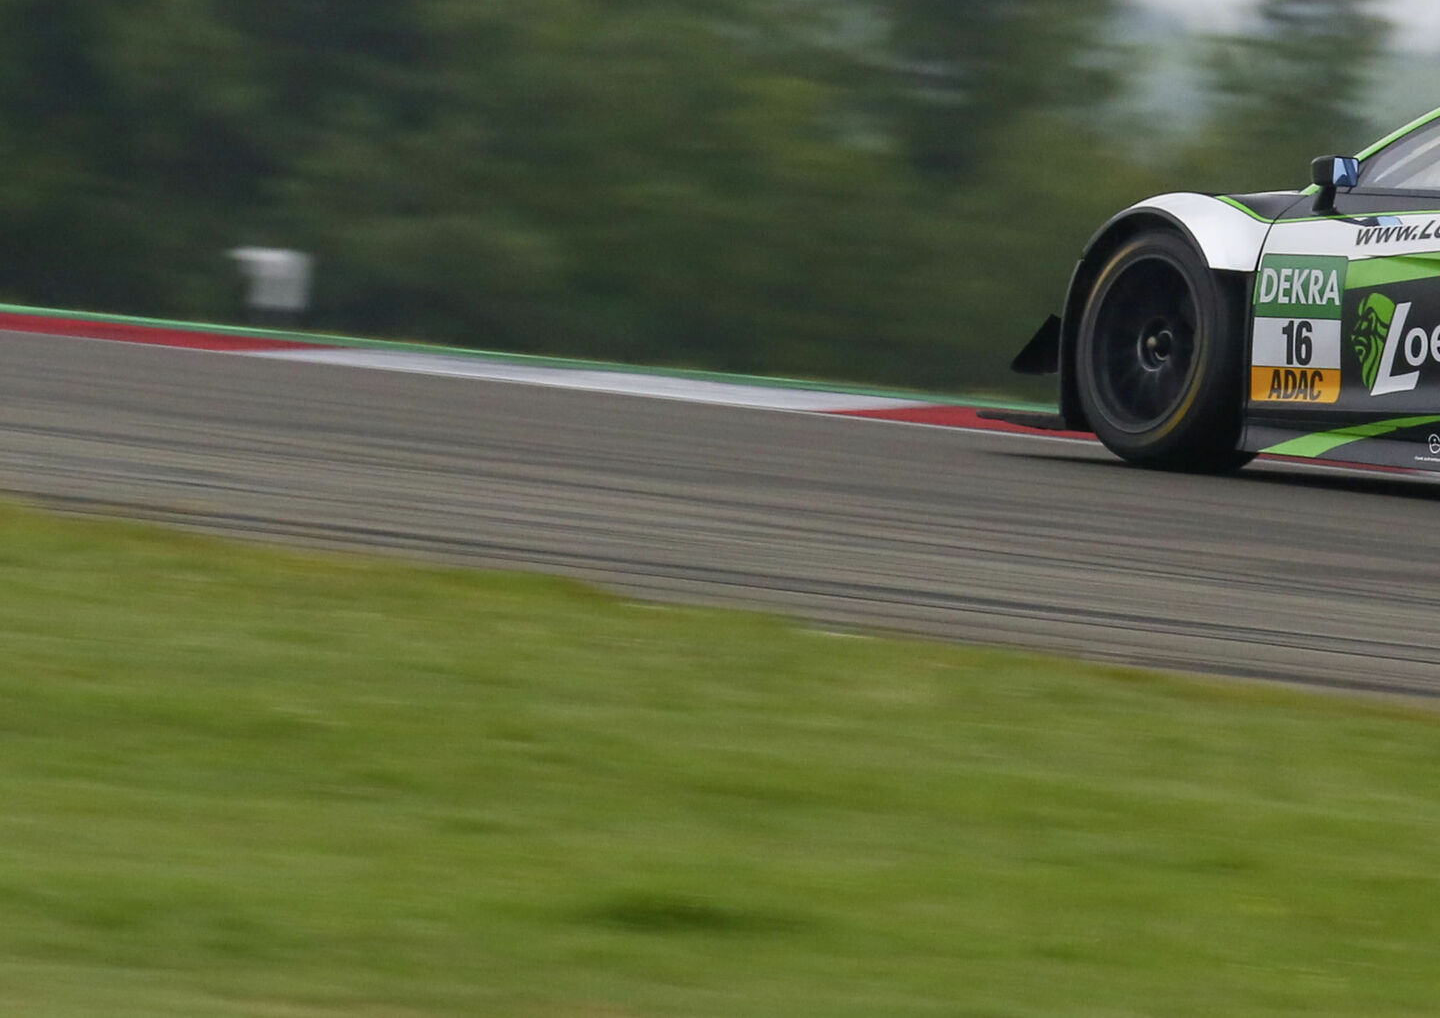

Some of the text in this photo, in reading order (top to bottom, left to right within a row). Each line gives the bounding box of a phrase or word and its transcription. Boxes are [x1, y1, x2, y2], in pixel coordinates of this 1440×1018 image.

[1259, 267, 1341, 305] DEKRA
[1282, 320, 1312, 366] 16
[1268, 369, 1323, 401] ADAC
